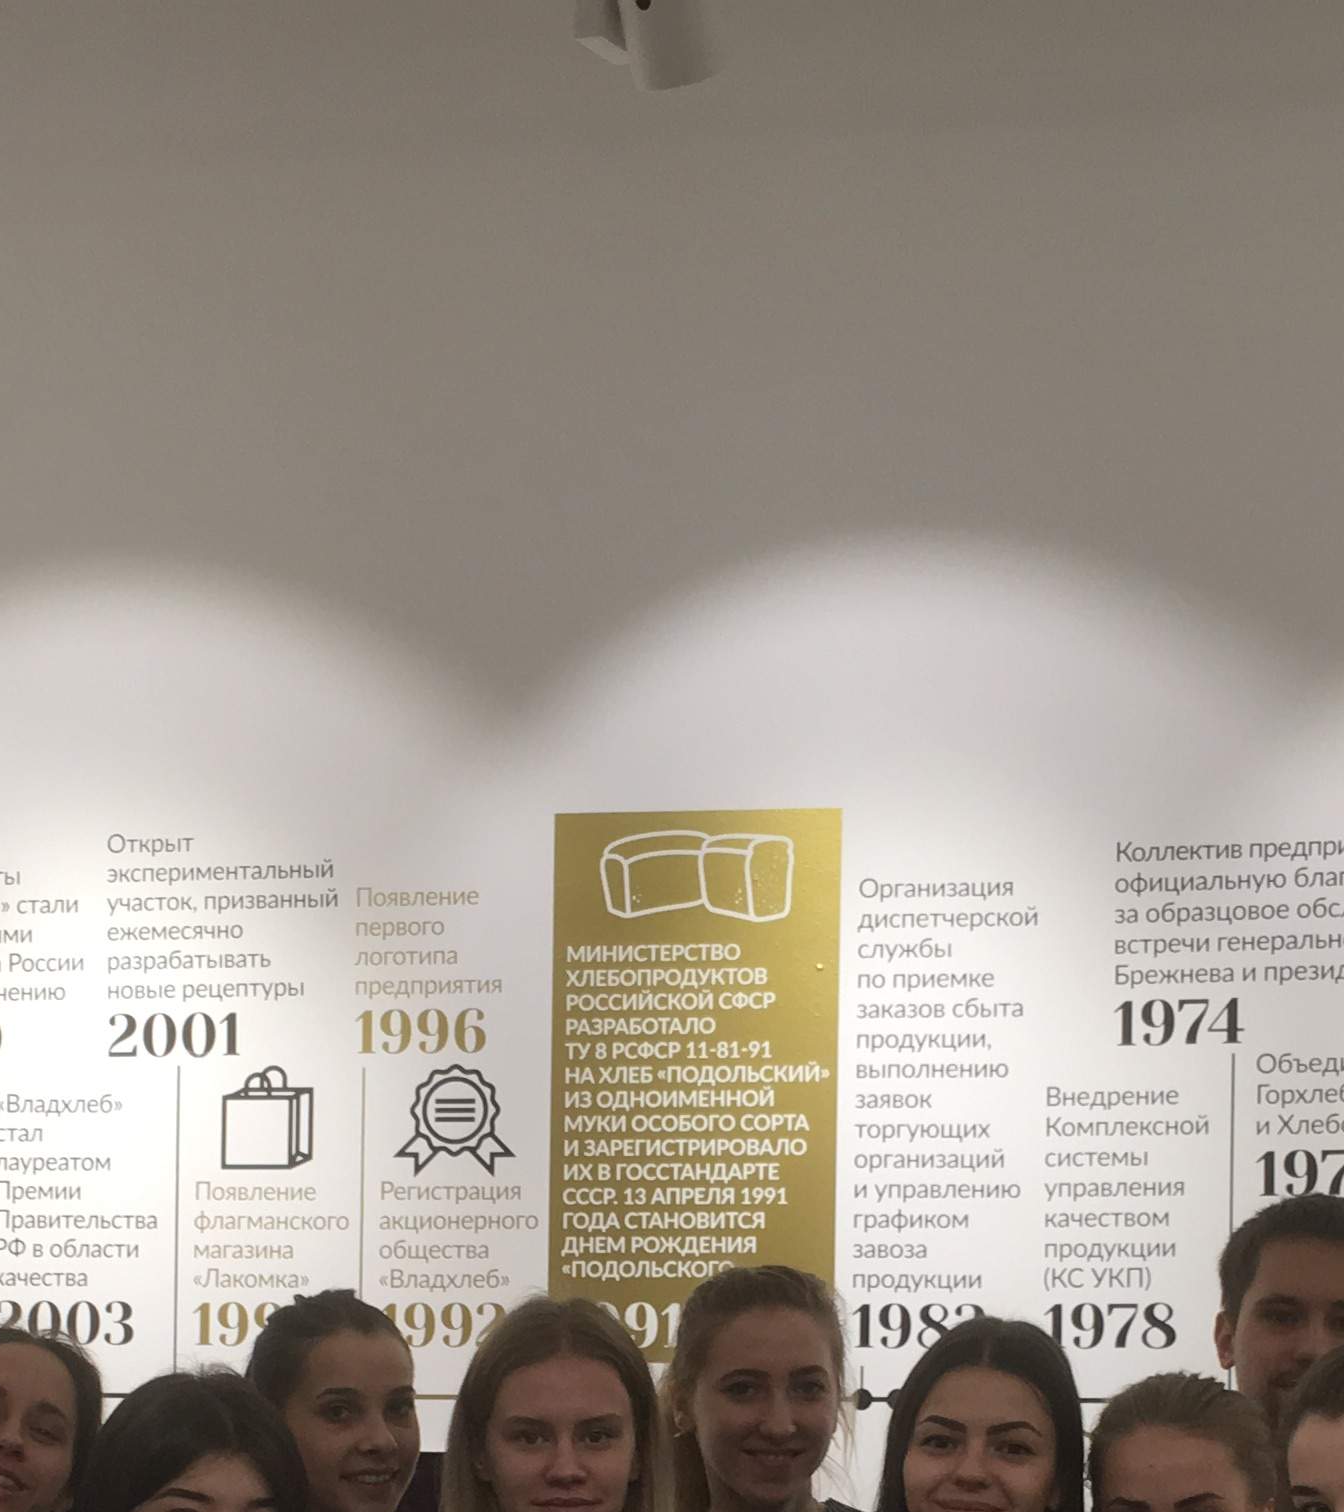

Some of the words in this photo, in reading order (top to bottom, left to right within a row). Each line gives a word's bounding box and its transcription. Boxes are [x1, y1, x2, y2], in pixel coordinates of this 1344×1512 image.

[106, 832, 196, 858] Открыт
[1115, 840, 1244, 864] Коллектив
[106, 857, 335, 888] экспериментальный
[1114, 870, 1288, 898] официальную
[106, 894, 198, 917] участок,
[203, 887, 339, 916] призванный
[355, 885, 480, 909] Появление
[858, 876, 1014, 904] Организация
[16, 898, 79, 916] стали
[856, 904, 1039, 934] диспетчерской
[1145, 900, 1291, 929] образцовое
[106, 923, 244, 942] ежемесячно
[8, 951, 85, 974] России
[107, 949, 272, 976] разрабатывать
[353, 948, 459, 968] логотипа
[566, 942, 742, 964] МИНИСТЕРСТВО
[857, 936, 953, 965] службы
[565, 966, 769, 990] ХЛЕБОПРОДУКТОВ
[892, 971, 996, 993] приемке
[1114, 962, 1235, 990] Брежнева
[182, 980, 305, 1004] рецептуры
[354, 977, 503, 1002] предприятия
[565, 987, 714, 1013] РОССИЙСКОЙ
[718, 990, 777, 1011] СФСР
[856, 1002, 946, 1021] заказов
[951, 996, 1025, 1019] сбыта
[354, 1006, 487, 1056] 1996
[565, 1015, 717, 1037] РАЗРАБОТАЛО
[1114, 996, 1245, 1048] 1974
[108, 1011, 240, 1059] 2001
[856, 1032, 992, 1054] продукции,
[611, 1040, 682, 1061] РСФСР
[686, 1039, 773, 1060] 11-81-91
[598, 1064, 654, 1085] ХЛЕБ
[656, 1060, 831, 1088] «ПОДОЛЬСКИЙ»
[855, 1061, 1010, 1080] выполнению
[595, 1084, 775, 1113] ОДНОИМЕННОЙ
[855, 1093, 933, 1111] заявок
[1045, 1085, 1180, 1111] Внедрение
[563, 1114, 627, 1134] МУКИ
[630, 1112, 737, 1134] ОСОБОГО
[739, 1112, 811, 1133] СОРТА
[853, 1122, 991, 1145] торгующих
[1045, 1113, 1210, 1138] Комплексной
[583, 1136, 808, 1158] ЗАРЕГИСТРИРОВАЛО
[853, 1147, 1005, 1175] организаций
[1044, 1150, 1149, 1169] системы
[615, 1161, 781, 1185] ГОССТАНДАРТЕ
[380, 1179, 522, 1206] Регистрация
[562, 1186, 619, 1206] СССР.
[649, 1185, 736, 1206] АПРЕЛЯ
[740, 1185, 789, 1205] 1991
[873, 1182, 1022, 1204] управлению
[1043, 1179, 1186, 1204] управления
[193, 1209, 351, 1235] флагманского
[378, 1213, 540, 1236] акционерного
[562, 1210, 621, 1234] ГОДА
[623, 1210, 766, 1231] СТАНОВИТСЯ
[852, 1207, 970, 1235] графиком
[1044, 1210, 1171, 1229] качеством
[49, 1237, 140, 1259] области
[193, 1242, 295, 1261] магазина
[378, 1238, 491, 1265] общества
[560, 1234, 626, 1258] ДНЕМ
[630, 1234, 757, 1258] РОЖДЕНИЯ
[192, 1266, 310, 1290] «Лакомка»
[851, 1272, 983, 1295] продукции
[1043, 1266, 1085, 1293] (КС
[1090, 1265, 1152, 1293] УКП)
[1044, 1302, 1177, 1350] 1978
